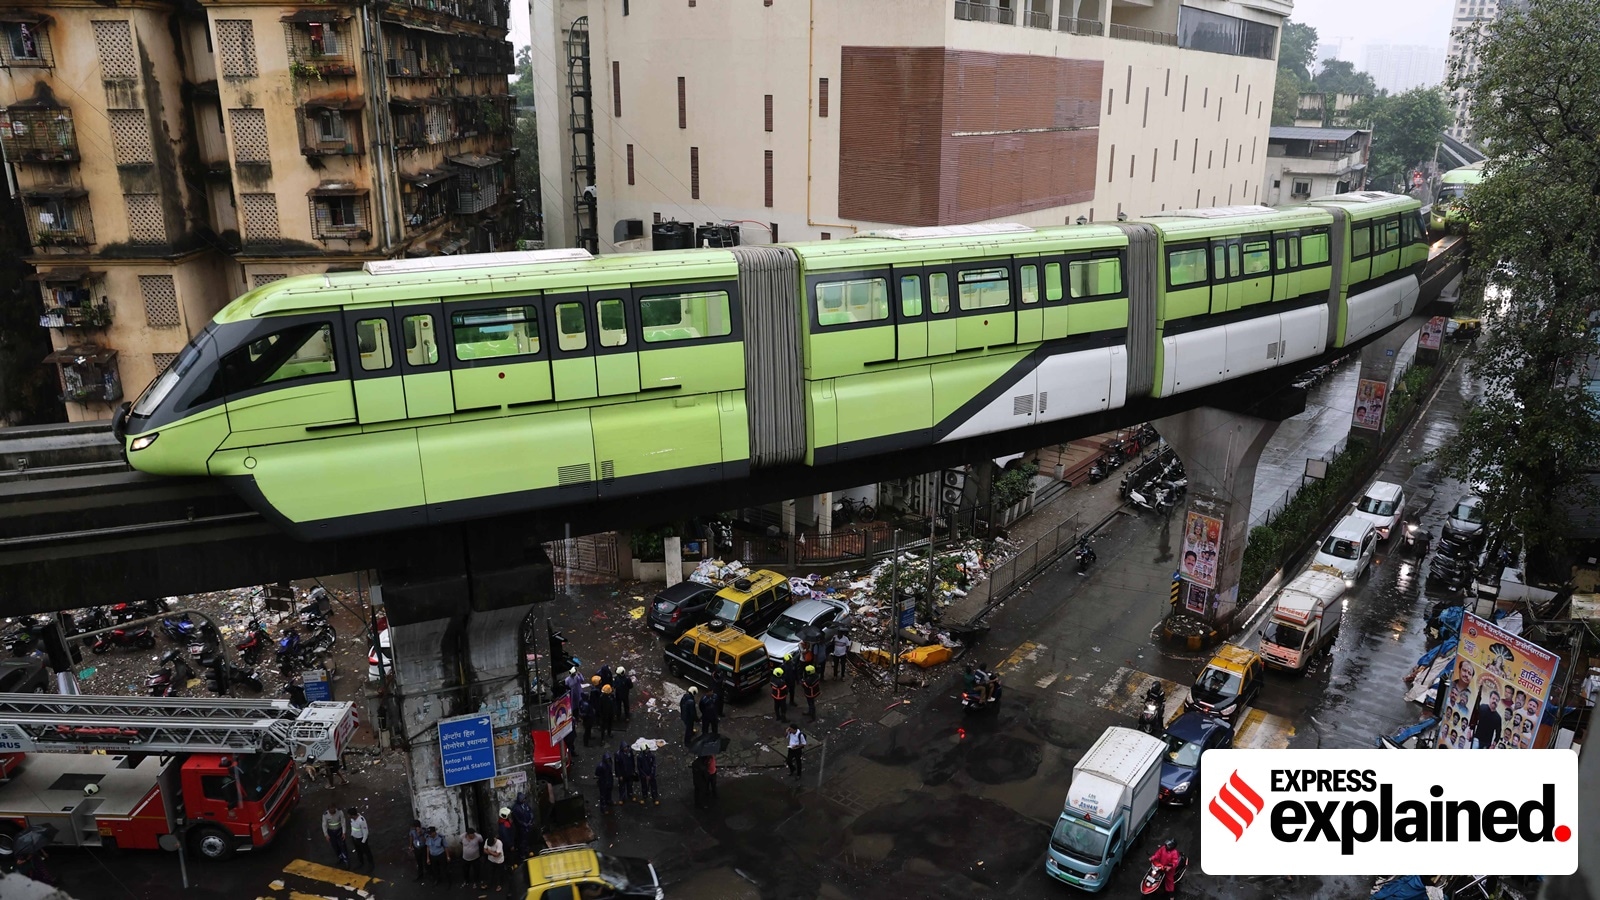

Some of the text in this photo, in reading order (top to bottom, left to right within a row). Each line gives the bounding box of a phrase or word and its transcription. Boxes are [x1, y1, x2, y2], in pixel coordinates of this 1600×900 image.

[1518, 677, 1542, 695] स्वागत
[463, 730, 475, 738] हिल
[443, 737, 488, 750] मोनोरेल स्थानक
[446, 761, 491, 773] Monorail Station
